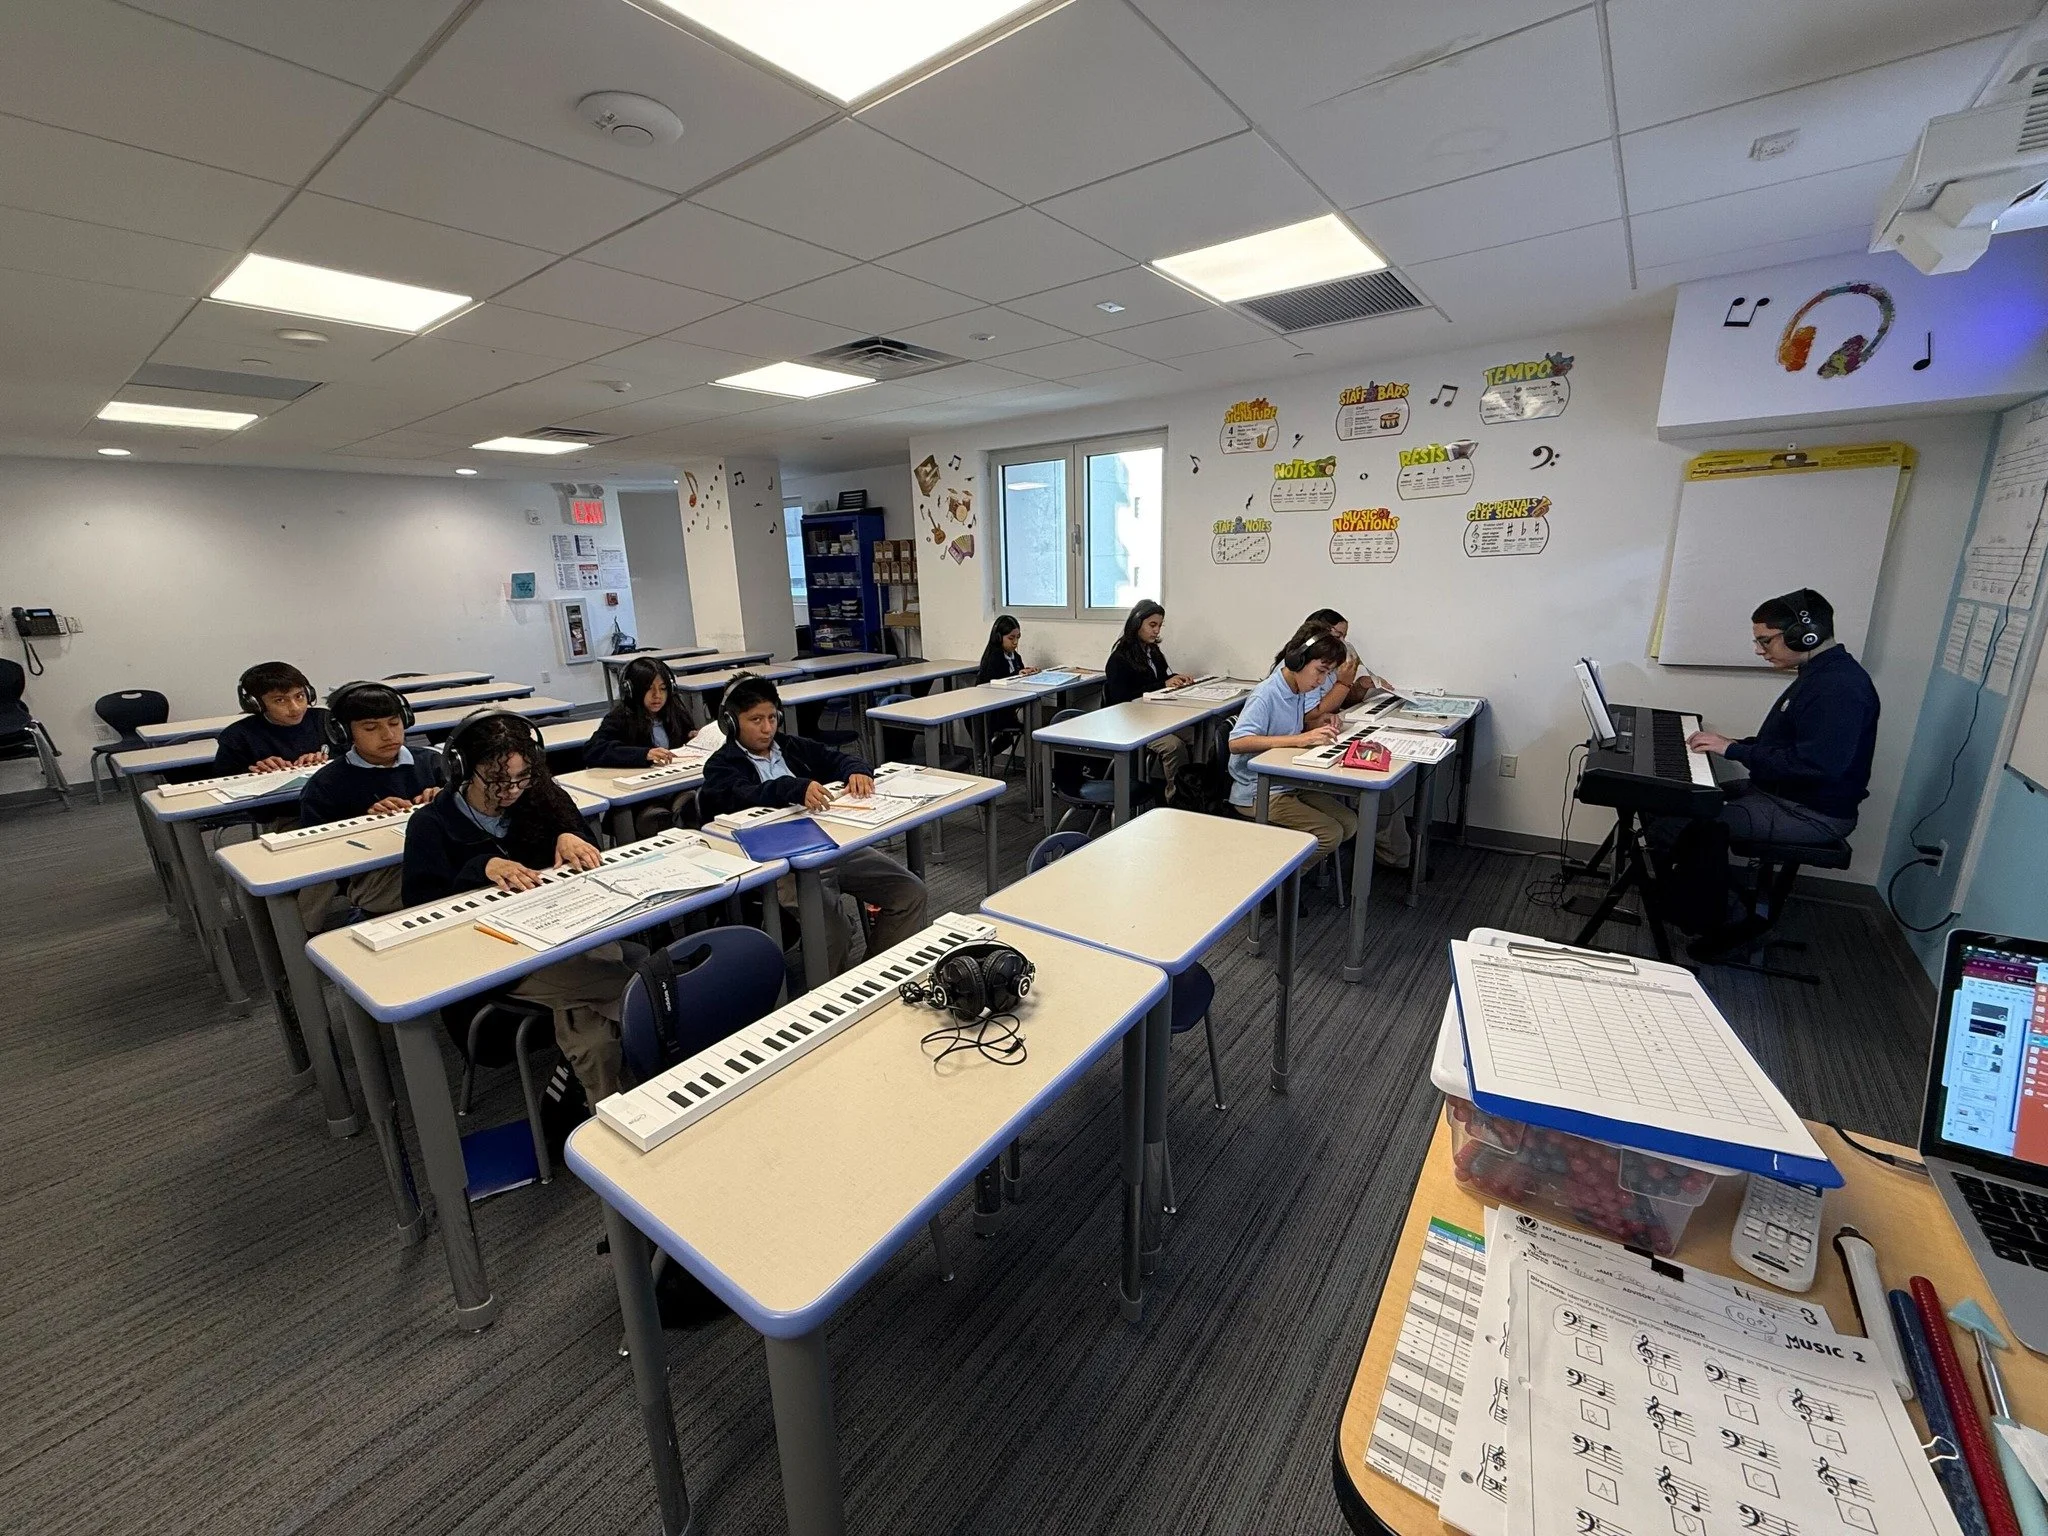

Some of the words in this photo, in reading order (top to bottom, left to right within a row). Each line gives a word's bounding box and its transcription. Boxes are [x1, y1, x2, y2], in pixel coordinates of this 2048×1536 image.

[1483, 358, 1553, 386] TEMPO
[1339, 386, 1368, 405] STAFF
[1377, 382, 1410, 400] BARS
[1224, 405, 1277, 423] SIGNATURE
[1228, 427, 1234, 435] 4
[1399, 444, 1445, 466] RESTS
[1274, 459, 1316, 480] NOTES
[1475, 498, 1538, 511] ACCIDENTALS
[1342, 509, 1378, 522] MUSIC
[1467, 508, 1492, 521] CLEF
[1495, 506, 1529, 520] SIGNS
[1245, 518, 1272, 533] NOTES
[1333, 517, 1400, 532] NOTATIONS
[1540, 1233, 1557, 1243] DATE
[1552, 1229, 1567, 1237] AND
[1583, 1240, 1602, 1250] NAME
[1552, 1260, 1568, 1270] DATE
[1758, 1250, 1785, 1266] EPSON
[1622, 1287, 1656, 1302] ADVISORY
[1800, 1307, 1818, 1325] 3
[1663, 1319, 1706, 1339] Homework
[1784, 1333, 1845, 1359] MUSIC
[1852, 1350, 1867, 1363] 2
[1667, 1440, 1686, 1456] E
[1752, 1473, 1767, 1488] C
[1597, 1481, 1613, 1496] A
